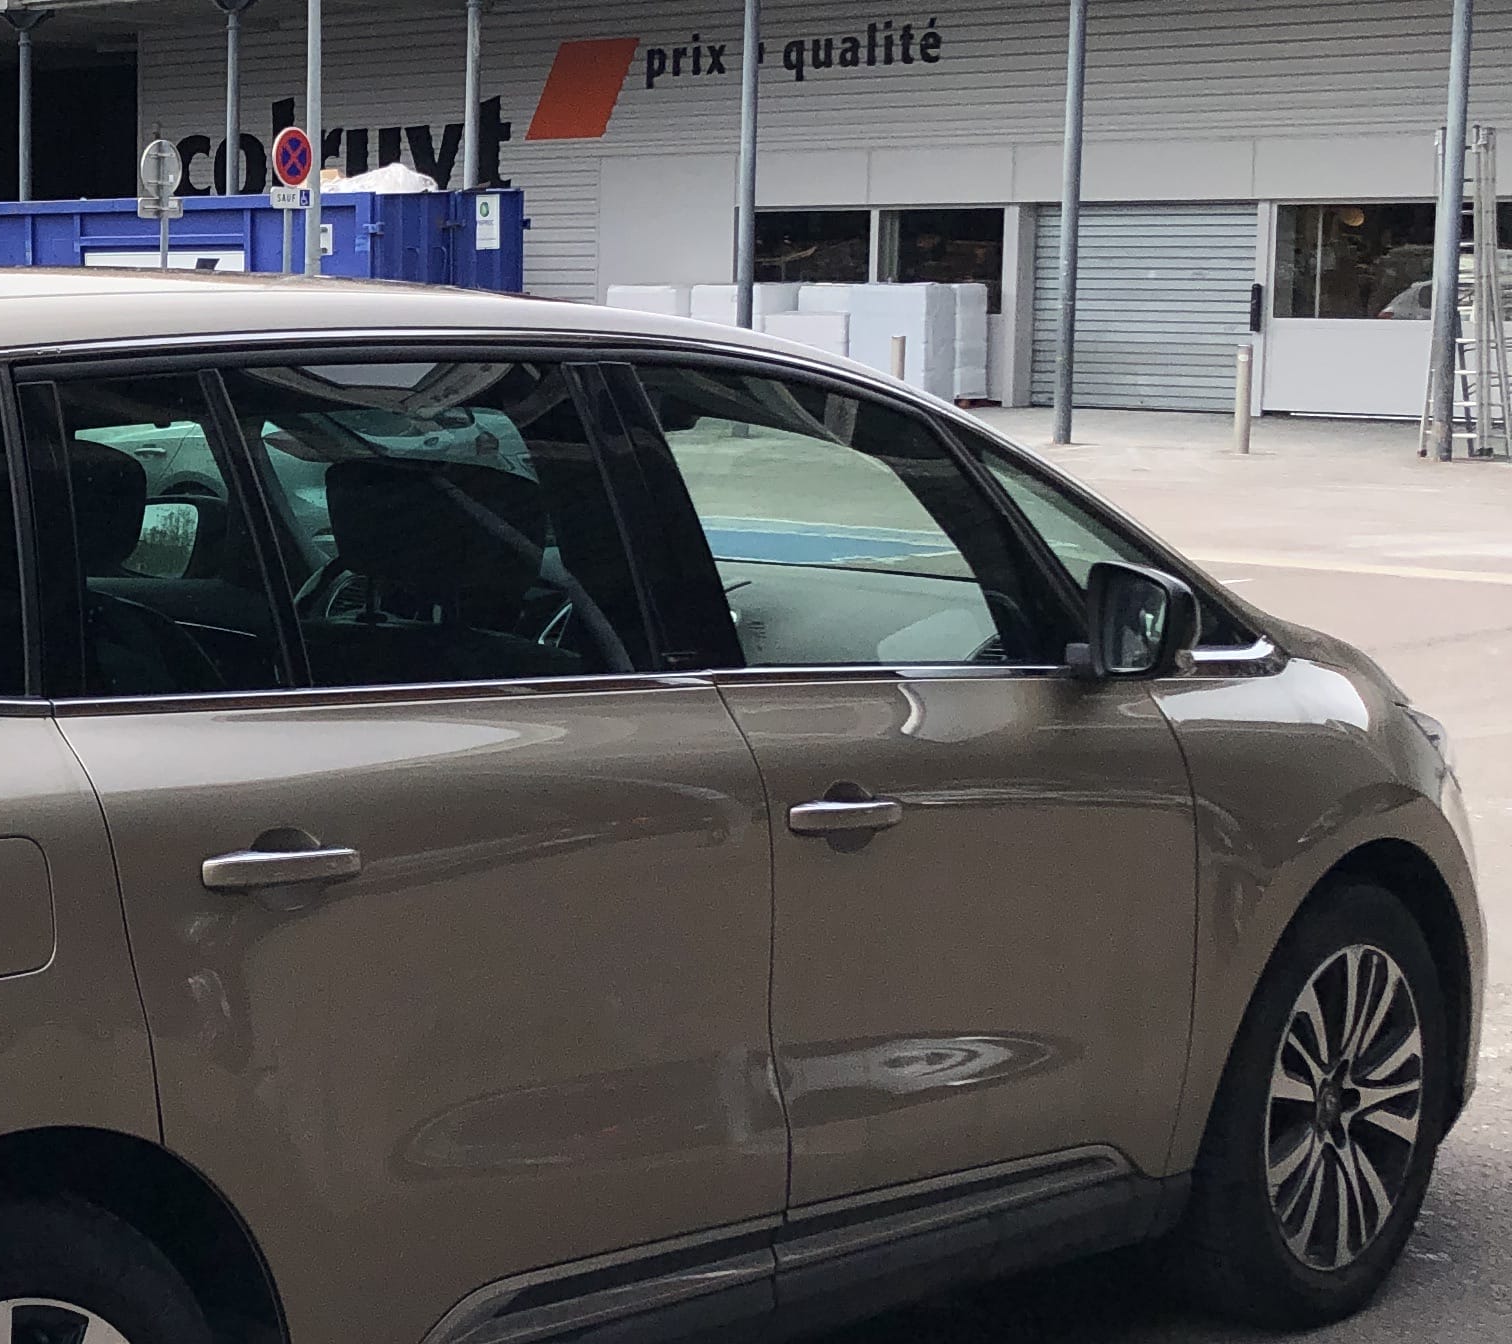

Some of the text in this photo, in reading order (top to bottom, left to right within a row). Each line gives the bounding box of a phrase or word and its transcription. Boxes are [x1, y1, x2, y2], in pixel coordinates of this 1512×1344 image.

[646, 17, 942, 89] prix qualité
[276, 193, 296, 203] SAUF
